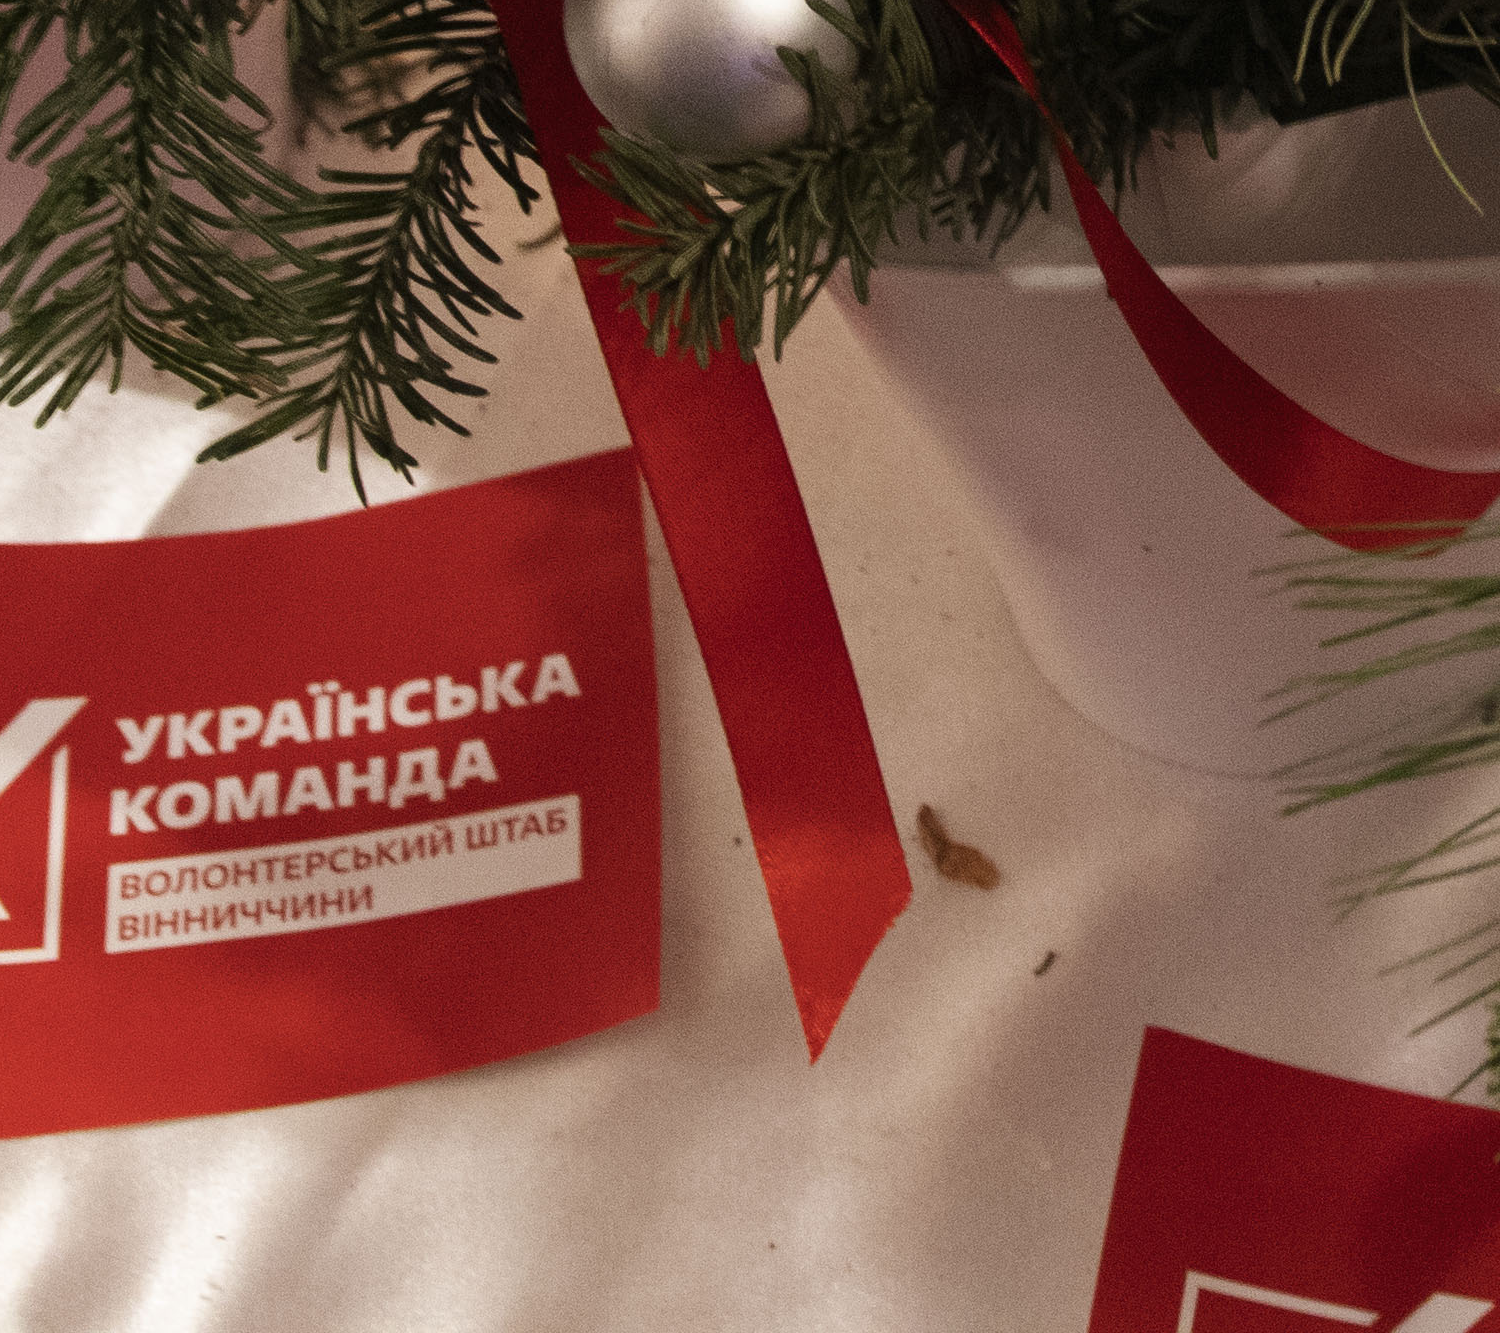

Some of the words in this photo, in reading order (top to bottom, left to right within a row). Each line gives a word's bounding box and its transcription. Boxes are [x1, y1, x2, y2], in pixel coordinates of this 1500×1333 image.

[114, 652, 582, 764] УКРАЇНСЬКА
[108, 738, 499, 836] КОМАНДА
[119, 819, 456, 901] ВОЛОНТЕРСЬКИЙ
[464, 807, 568, 851] ШТАБ
[117, 884, 375, 942] ВІННИЧЧИНИ
